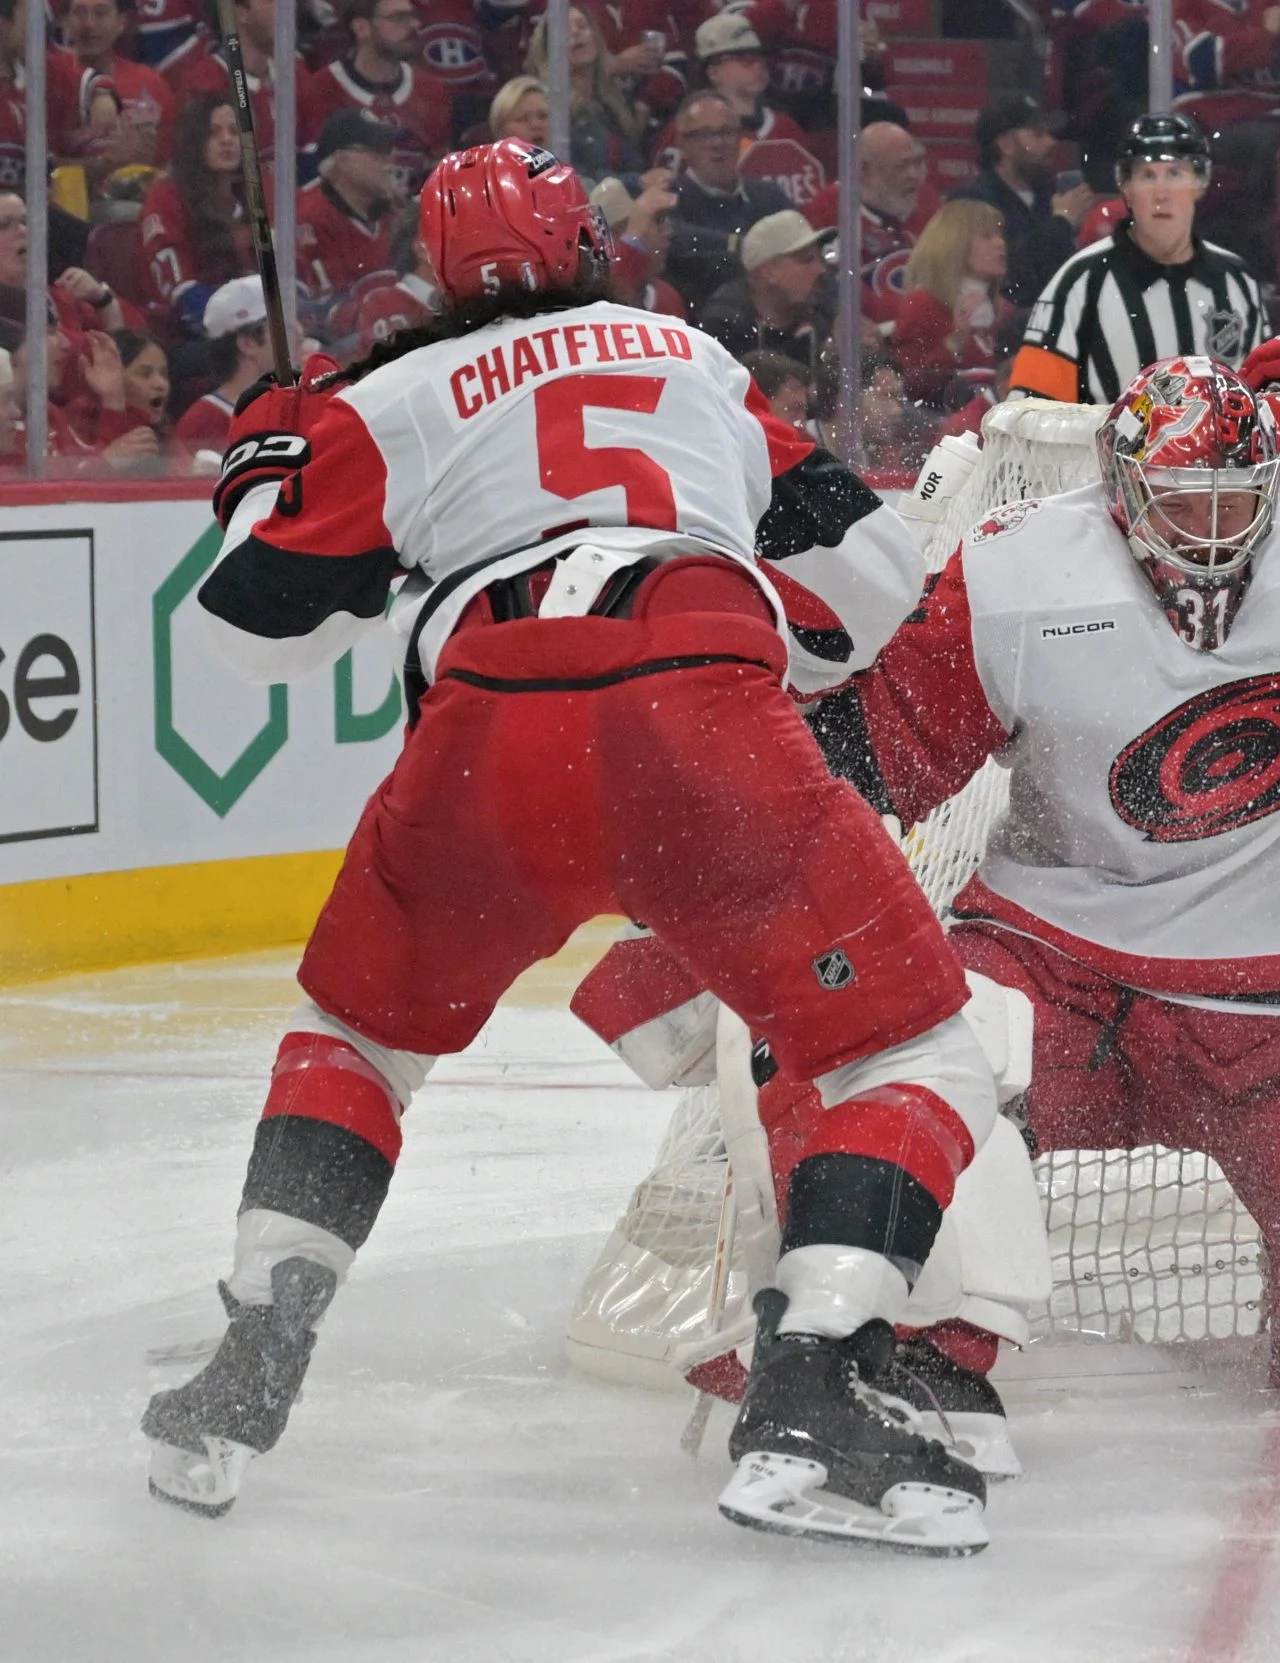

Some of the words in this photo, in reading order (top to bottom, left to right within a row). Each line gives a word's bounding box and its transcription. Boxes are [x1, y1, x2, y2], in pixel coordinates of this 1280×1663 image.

[480, 262, 500, 295] 5
[449, 323, 693, 420] CHATFIELD
[221, 435, 308, 481] CC
[534, 373, 678, 541] 5
[1042, 620, 1116, 638] NUCOR
[1176, 588, 1230, 651] 31
[0, 632, 81, 743] e
